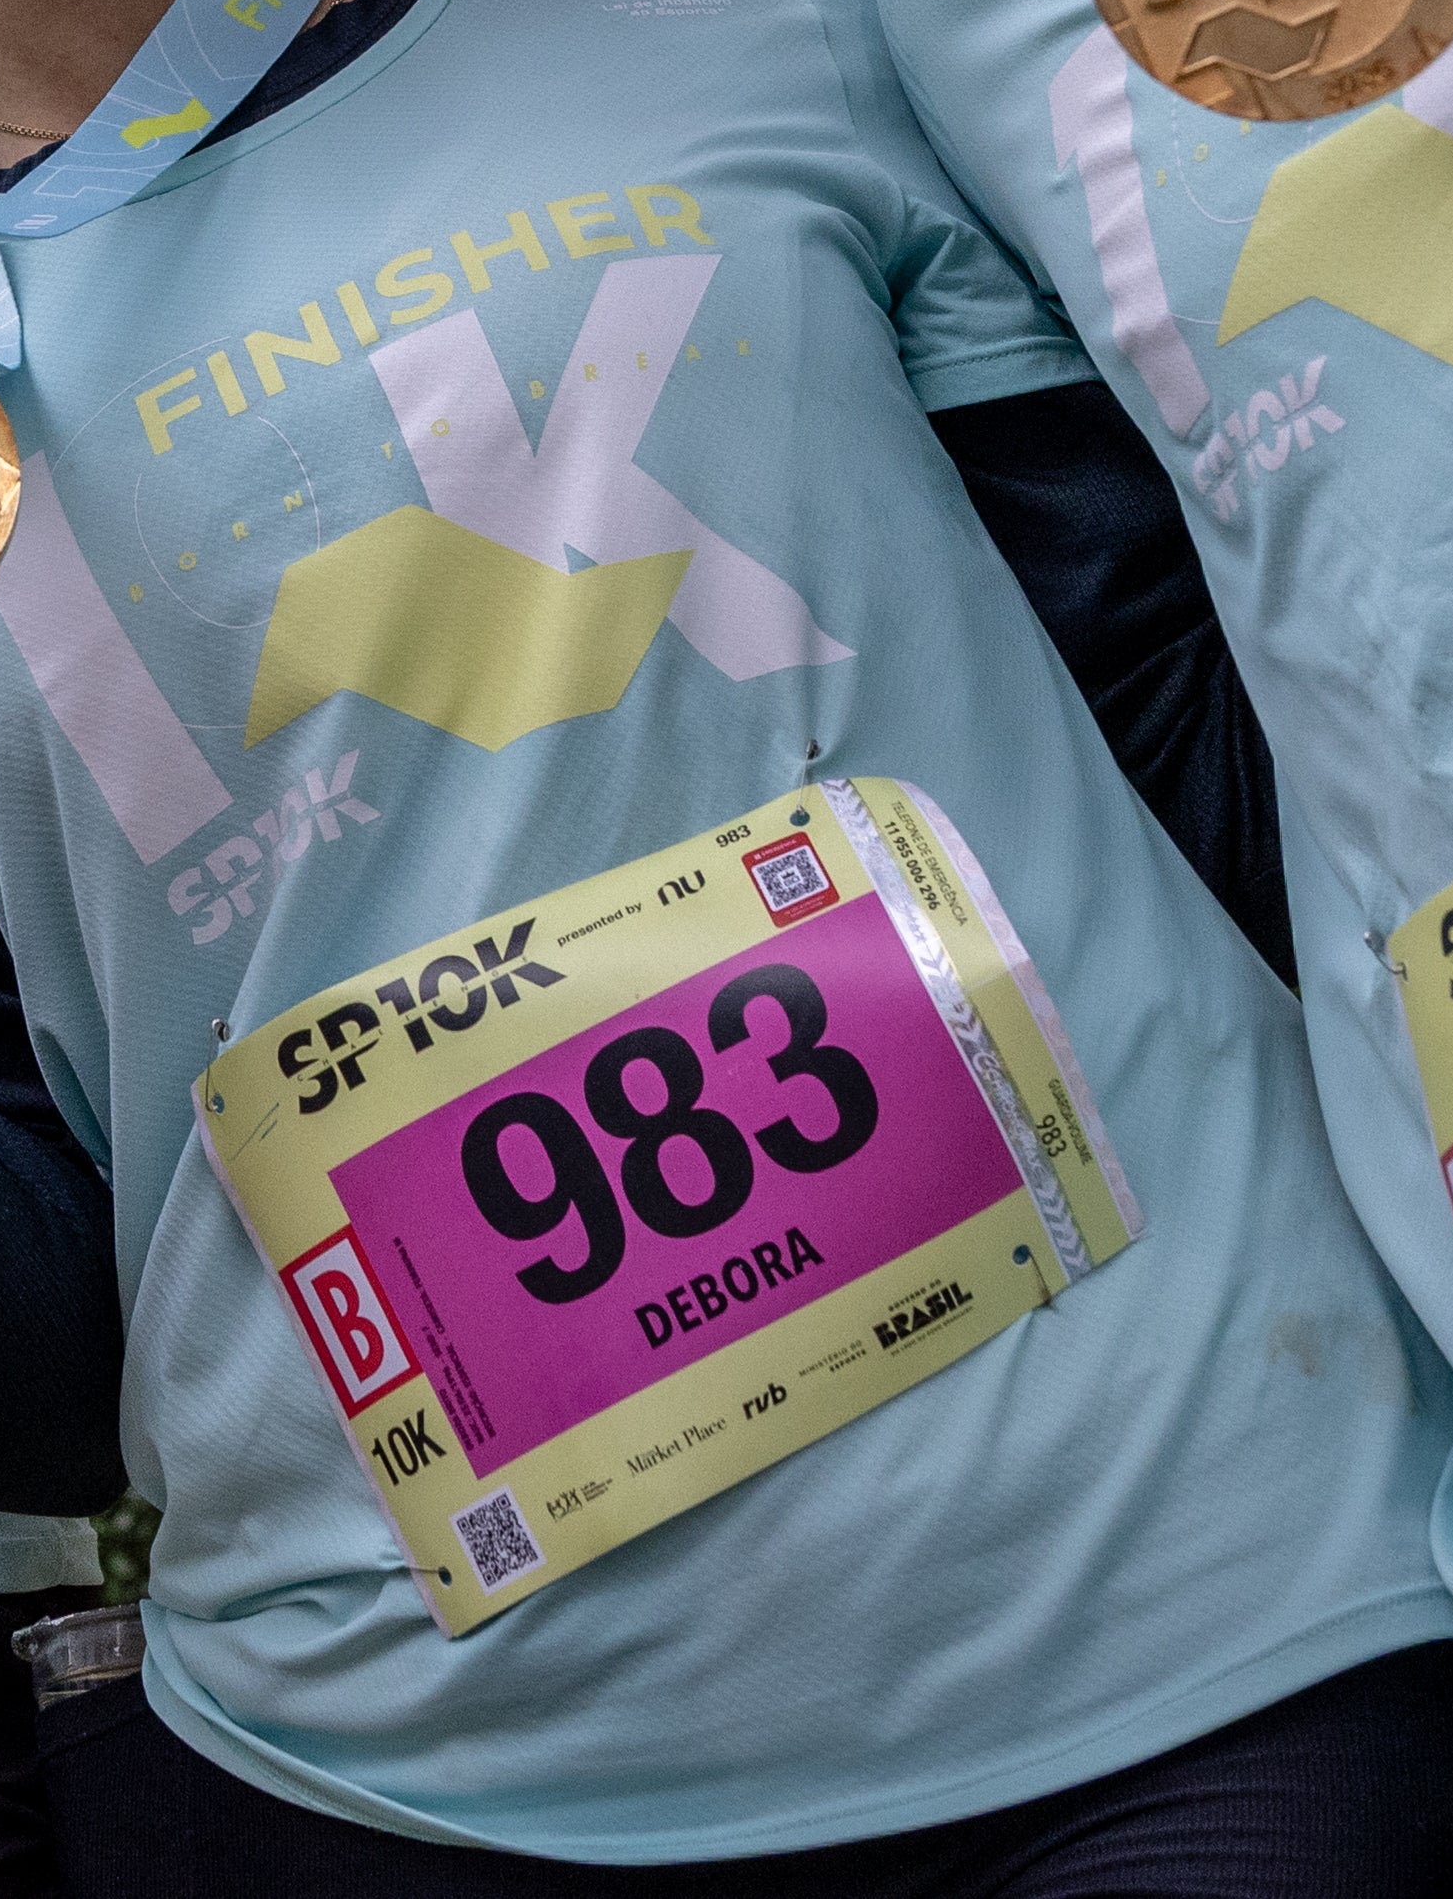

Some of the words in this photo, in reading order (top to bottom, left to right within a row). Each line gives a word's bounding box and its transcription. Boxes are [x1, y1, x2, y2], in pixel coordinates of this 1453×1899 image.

[135, 182, 716, 457] FINISHER
[167, 747, 382, 947] SP10K
[715, 823, 753, 850] 983
[884, 820, 901, 836] 11
[893, 836, 914, 859] 955
[905, 859, 927, 884] 006
[918, 884, 942, 911] 296
[892, 800, 925, 844] TELEFONE
[915, 839, 933, 858] DE
[924, 855, 969, 927] EMERGÊNCIA
[276, 916, 568, 1115] SP10K
[557, 909, 624, 948] presented
[625, 900, 645, 921] by
[655, 867, 707, 908] nu
[460, 961, 880, 1307] 983
[1035, 1113, 1068, 1158] 983
[318, 1268, 386, 1385] B
[633, 1226, 825, 1352] DEBORA
[872, 1281, 974, 1352] BRASIL
[370, 1410, 447, 1488] 10K
[681, 1415, 728, 1449] Place
[740, 1382, 788, 1421] rvb
